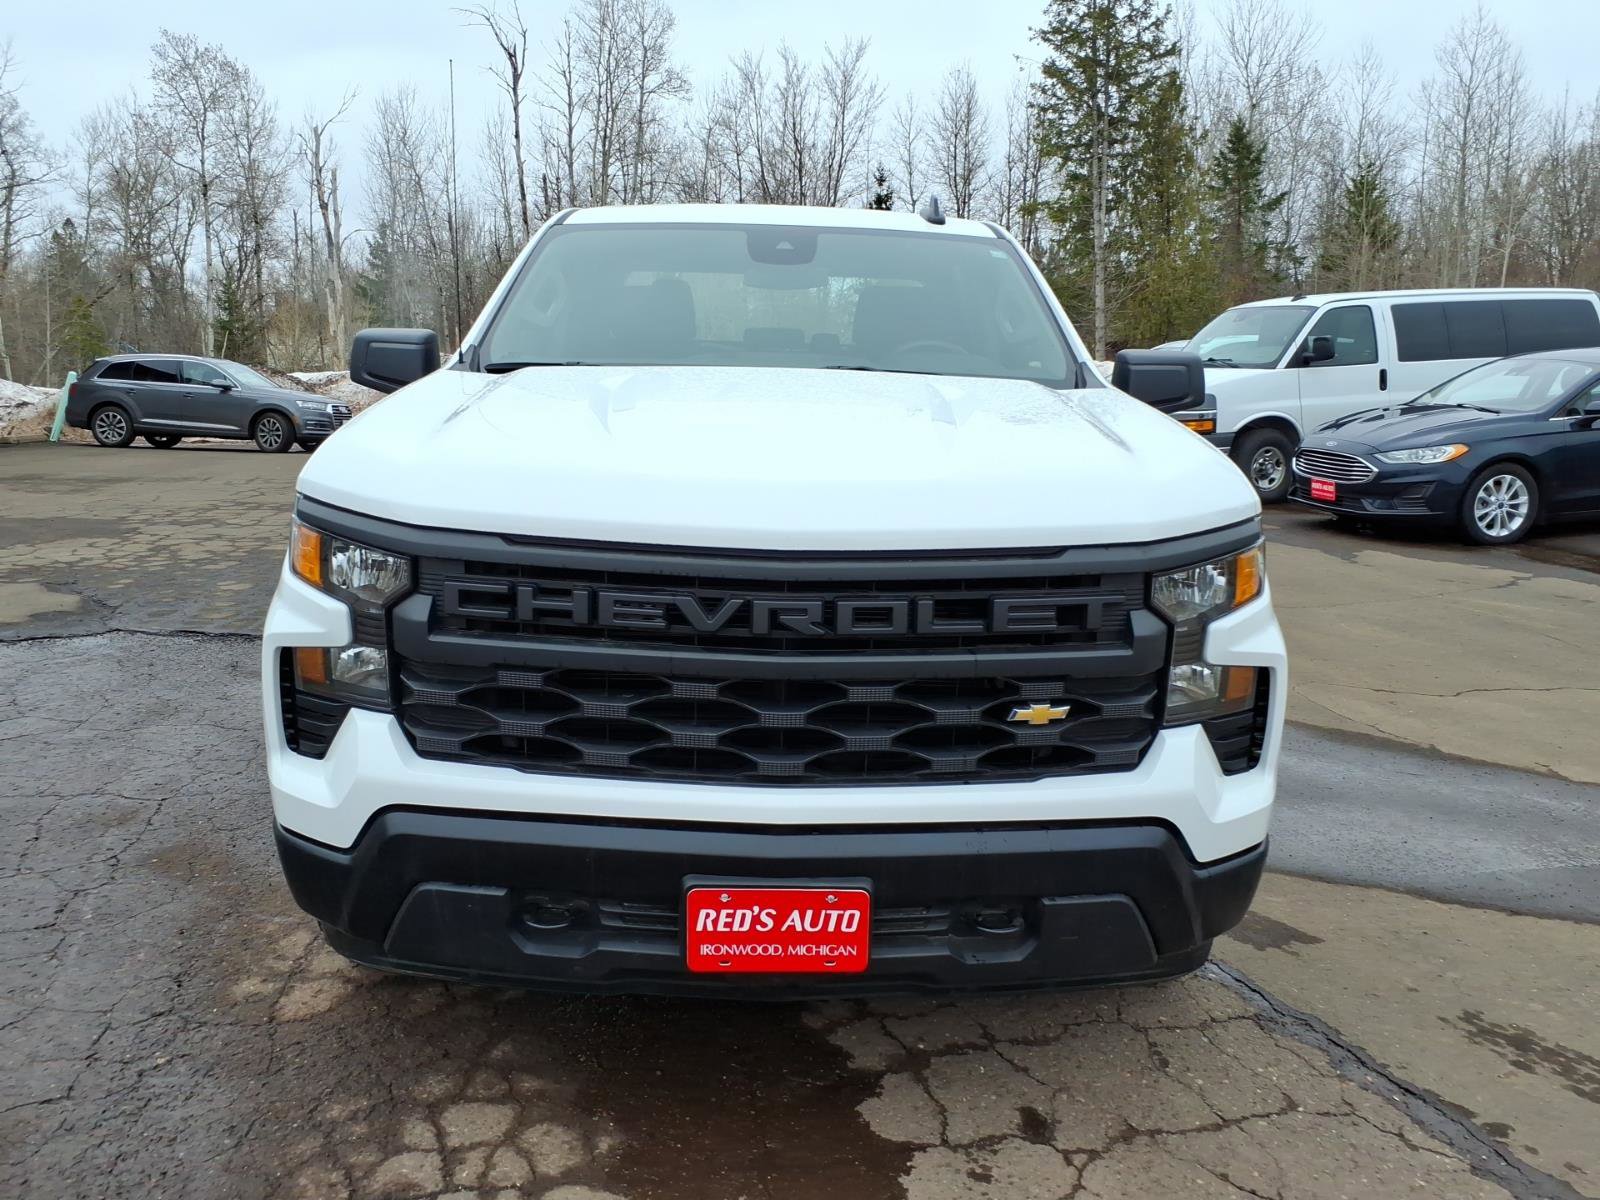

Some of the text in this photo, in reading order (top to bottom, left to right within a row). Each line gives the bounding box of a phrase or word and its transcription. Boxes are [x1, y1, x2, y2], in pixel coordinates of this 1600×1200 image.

[443, 577, 1127, 634] CHEVROLET
[696, 905, 861, 933] RED'S AUTO
[700, 944, 857, 957] IRONWOOD, MICHIGAN
